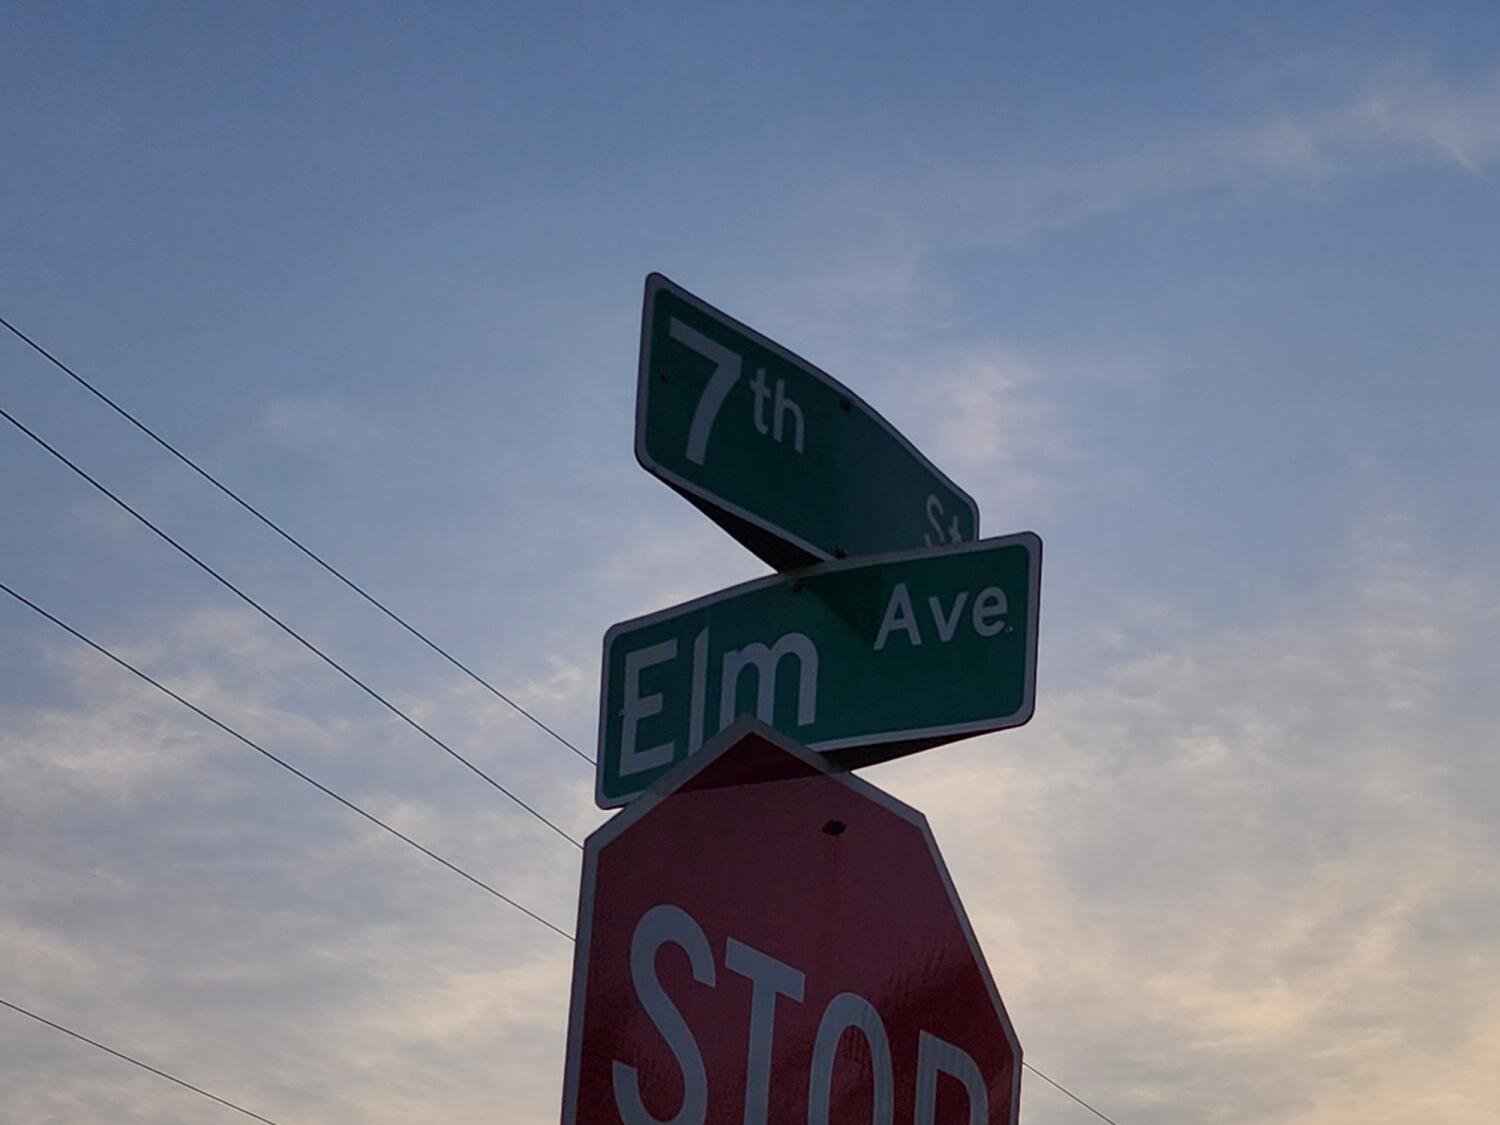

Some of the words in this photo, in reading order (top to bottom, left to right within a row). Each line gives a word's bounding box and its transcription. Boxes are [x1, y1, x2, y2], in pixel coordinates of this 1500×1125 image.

[668, 316, 805, 466] 7th
[619, 627, 819, 776] Elm
[873, 583, 1008, 650] Ave
